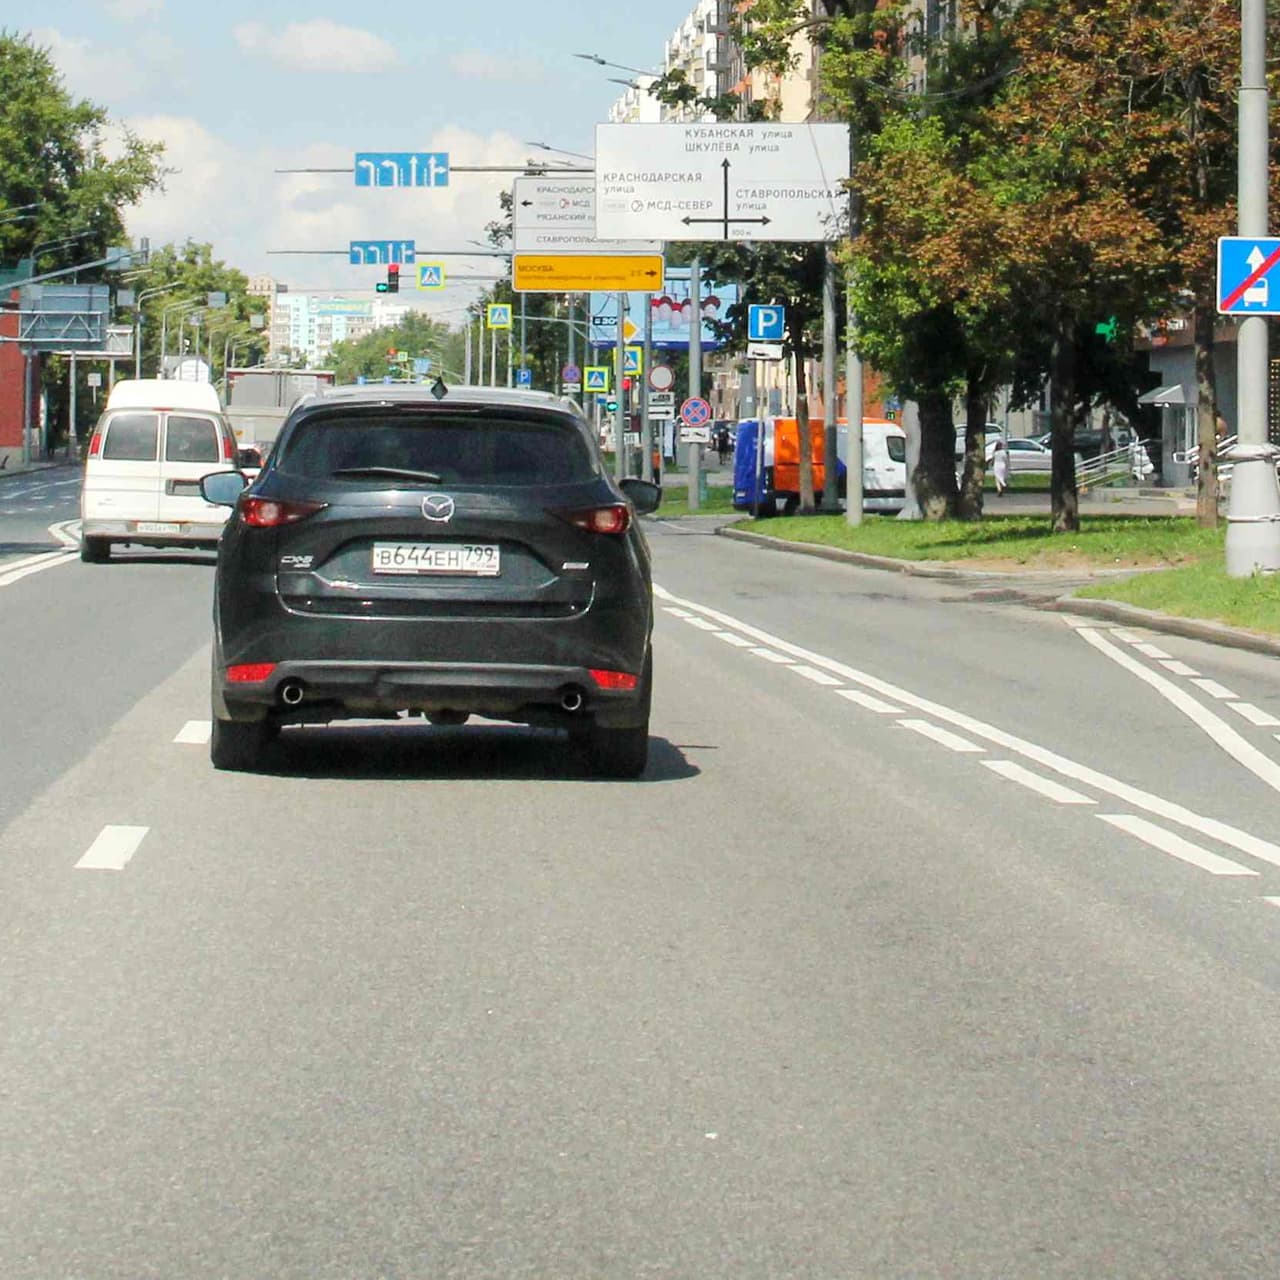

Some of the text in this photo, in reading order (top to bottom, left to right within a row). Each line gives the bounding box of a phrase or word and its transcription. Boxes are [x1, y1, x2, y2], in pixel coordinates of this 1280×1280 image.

[685, 128, 793, 140] КУБАНСКАЯ улица
[749, 144, 780, 154] улица
[603, 172, 703, 183] КРАСНОДАРСКАЯ
[604, 185, 635, 195] улица
[735, 188, 842, 199] СТАВРОПОЛЬСКАЯ
[647, 200, 713, 211] МСД-СЕВЕР
[736, 201, 768, 211] улица
[757, 308, 778, 337] P
[380, 545, 494, 567] В644ЕН 799
